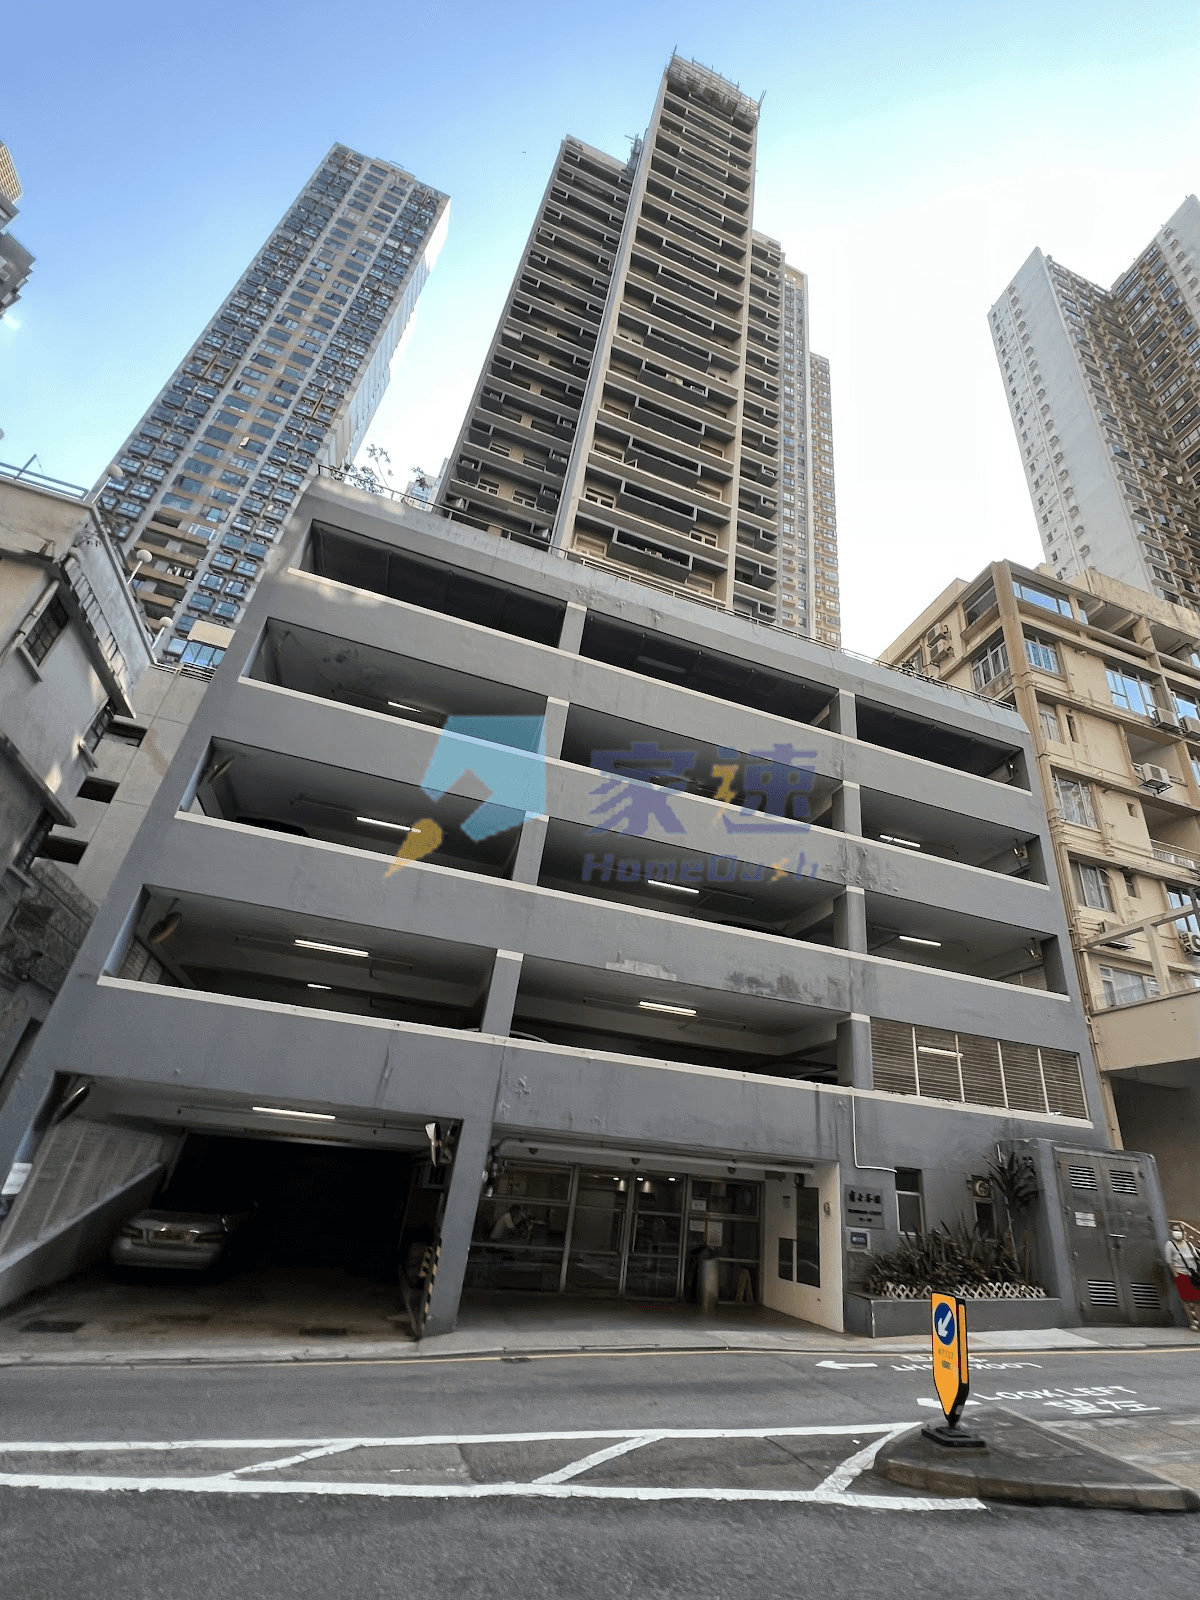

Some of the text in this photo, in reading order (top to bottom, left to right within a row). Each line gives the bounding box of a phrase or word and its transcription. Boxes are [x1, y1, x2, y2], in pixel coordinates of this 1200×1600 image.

[973, 1386, 1137, 1400] LOOK LEFT
[1043, 1399, 1161, 1414] 望左
